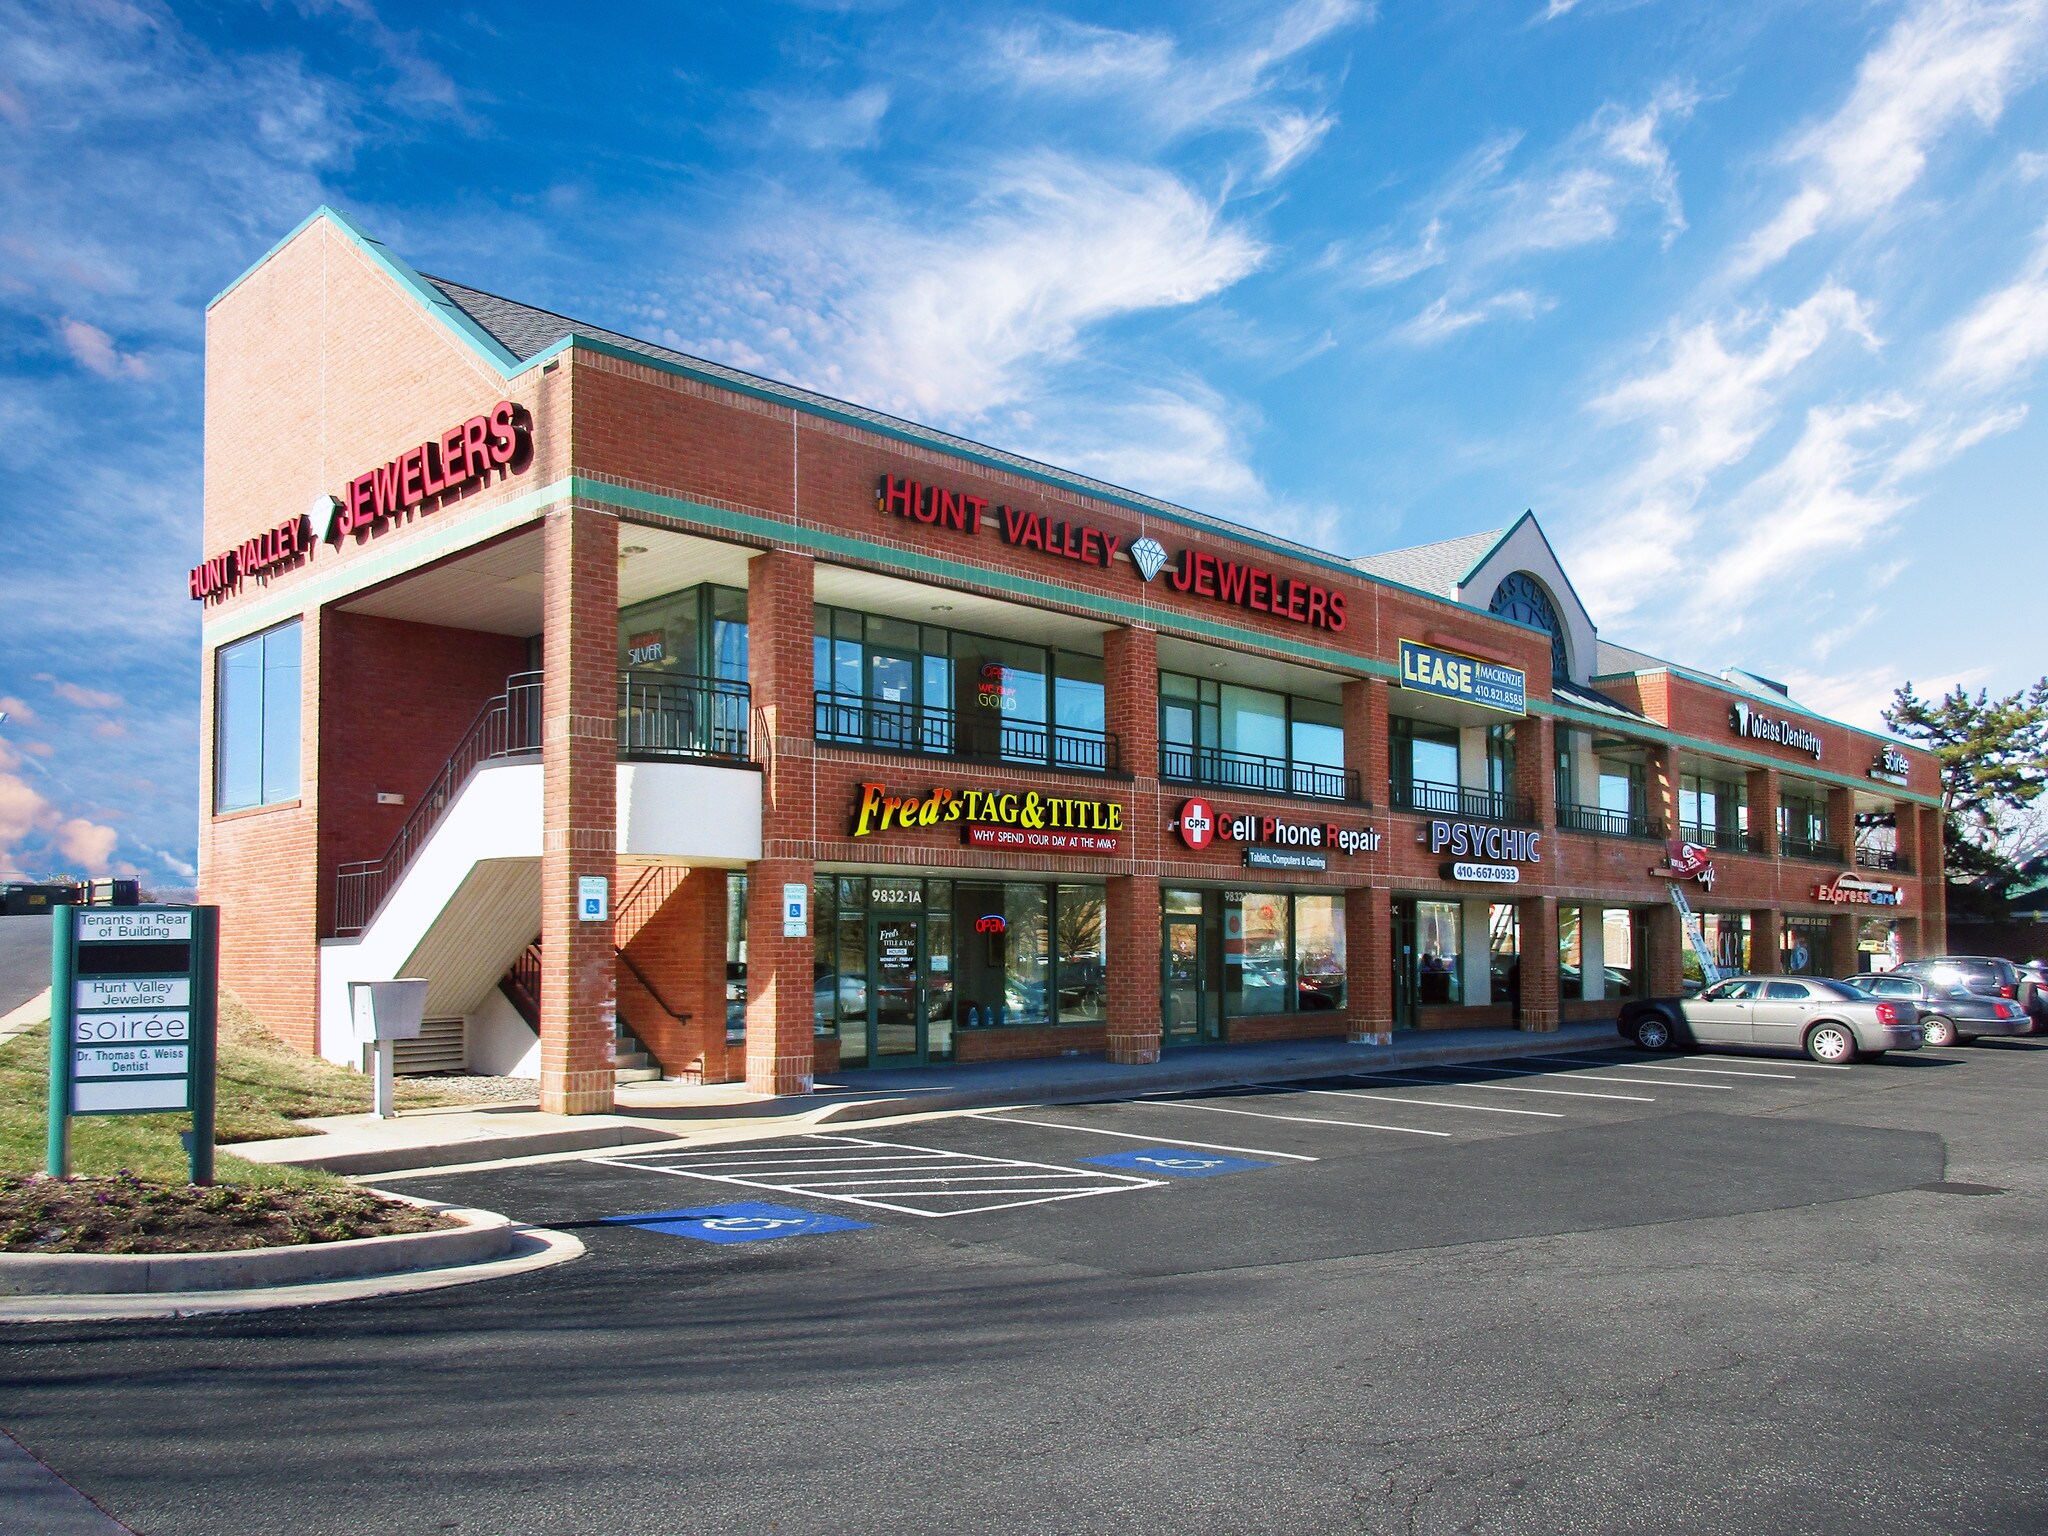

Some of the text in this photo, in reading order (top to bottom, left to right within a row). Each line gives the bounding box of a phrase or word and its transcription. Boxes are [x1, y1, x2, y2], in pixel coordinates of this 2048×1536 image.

[189, 400, 517, 599] HUNT VALLEY JEWELERS
[885, 473, 1348, 632] HUNT VALLEY JEWELERS
[629, 643, 662, 665] SILVER
[984, 666, 1014, 680] OPEN
[1404, 650, 1472, 693] LEASE
[1481, 666, 1522, 687] MACKENZIE
[978, 693, 1017, 710] GOLD
[1475, 685, 1522, 705] 410.821.8585
[1749, 712, 1821, 760] Weiss Dentistry
[854, 783, 963, 836] Fred's
[1188, 818, 1206, 830] CPR
[973, 830, 1117, 850] WHY SPEND YOUR DAY AT THE MVA?
[1218, 813, 1381, 856] Cell Phone Repair
[1432, 821, 1540, 863] PSYCHIC
[1272, 854, 1300, 866] Computers
[1306, 857, 1326, 870] Gaming
[872, 889, 922, 903] 9832-1A
[81, 914, 188, 926] Tenants in Rear
[976, 919, 1004, 933] OPEN
[99, 926, 170, 938] of Building
[94, 982, 173, 994] Hunt Valley
[103, 993, 165, 1005] Jewelers
[78, 1014, 185, 1040] soirée
[77, 1049, 184, 1061] Dr. Thomas G. Weiss
[112, 1061, 149, 1072] Dentist
